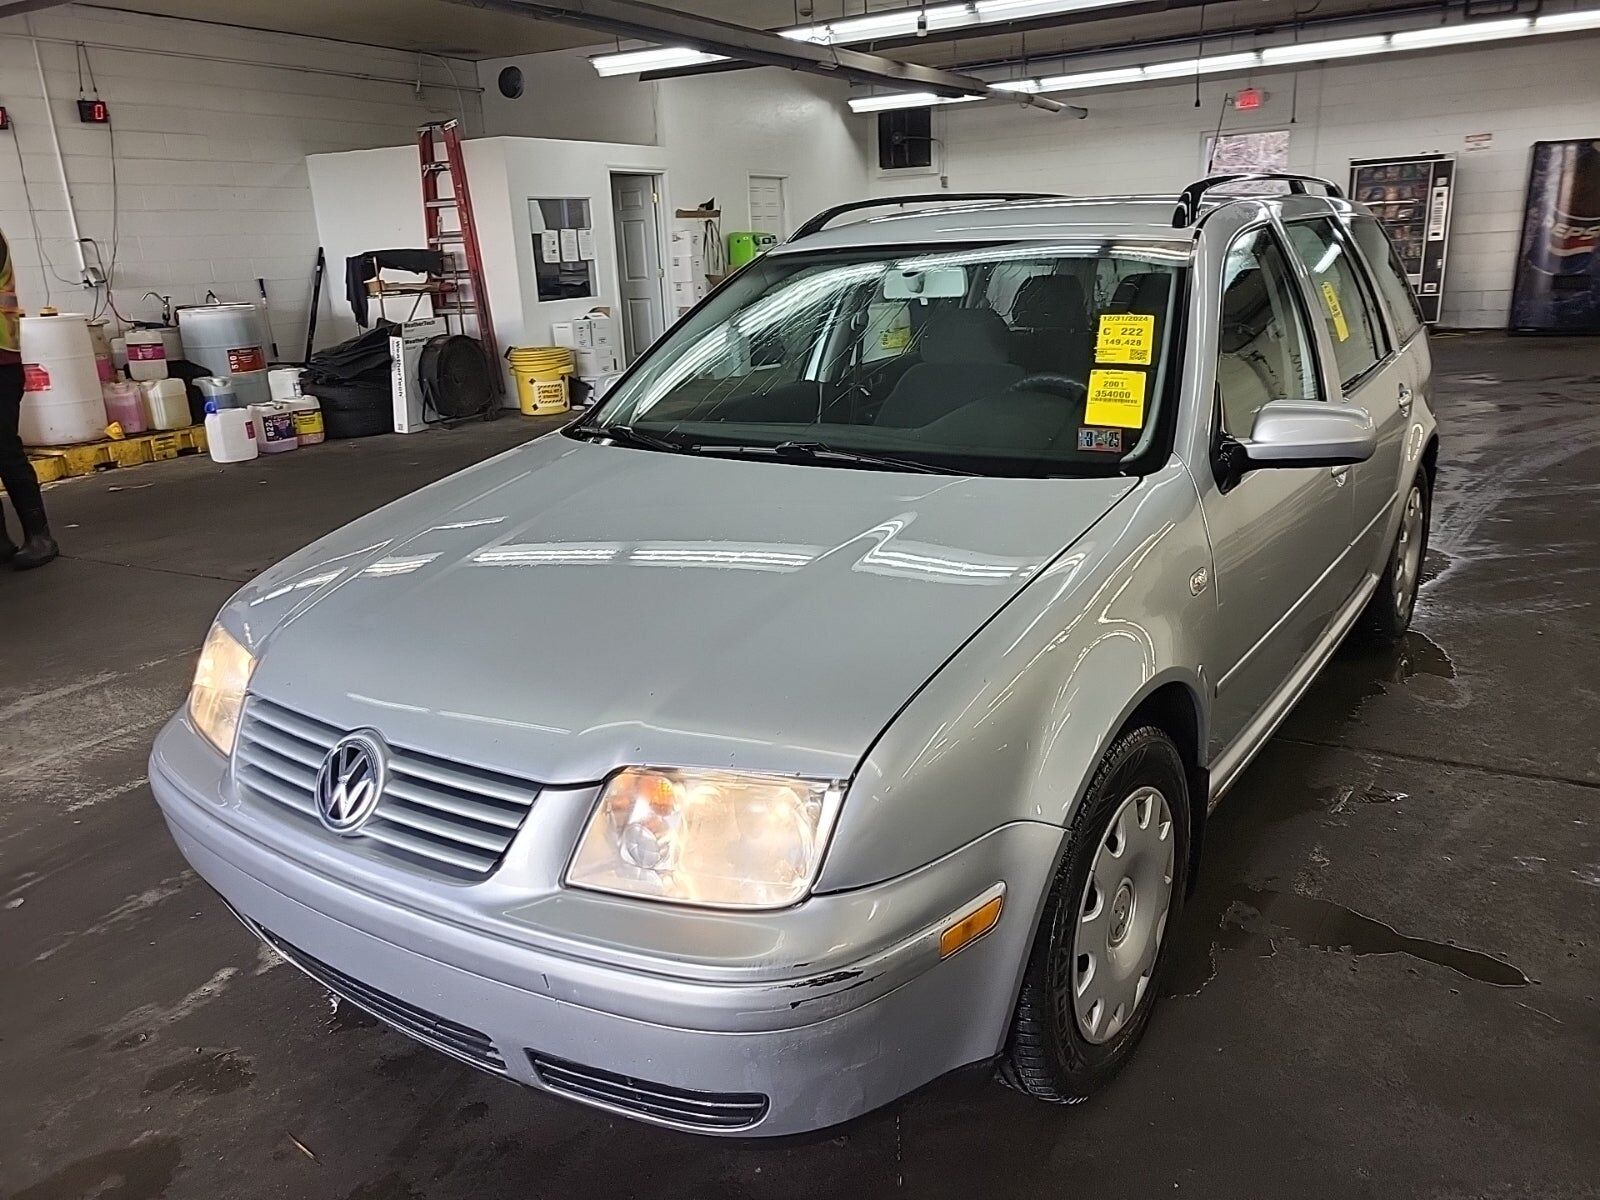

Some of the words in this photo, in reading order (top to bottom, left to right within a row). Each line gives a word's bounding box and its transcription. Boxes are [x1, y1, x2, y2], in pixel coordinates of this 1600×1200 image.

[95, 104, 104, 120] 0
[1551, 223, 1600, 240] EPS
[1103, 327, 1111, 336] C
[1120, 327, 1143, 336] 222
[229, 355, 239, 370] 510
[1103, 380, 1125, 388] 2001
[1095, 390, 1131, 399] 354000
[1108, 431, 1120, 448] 25
